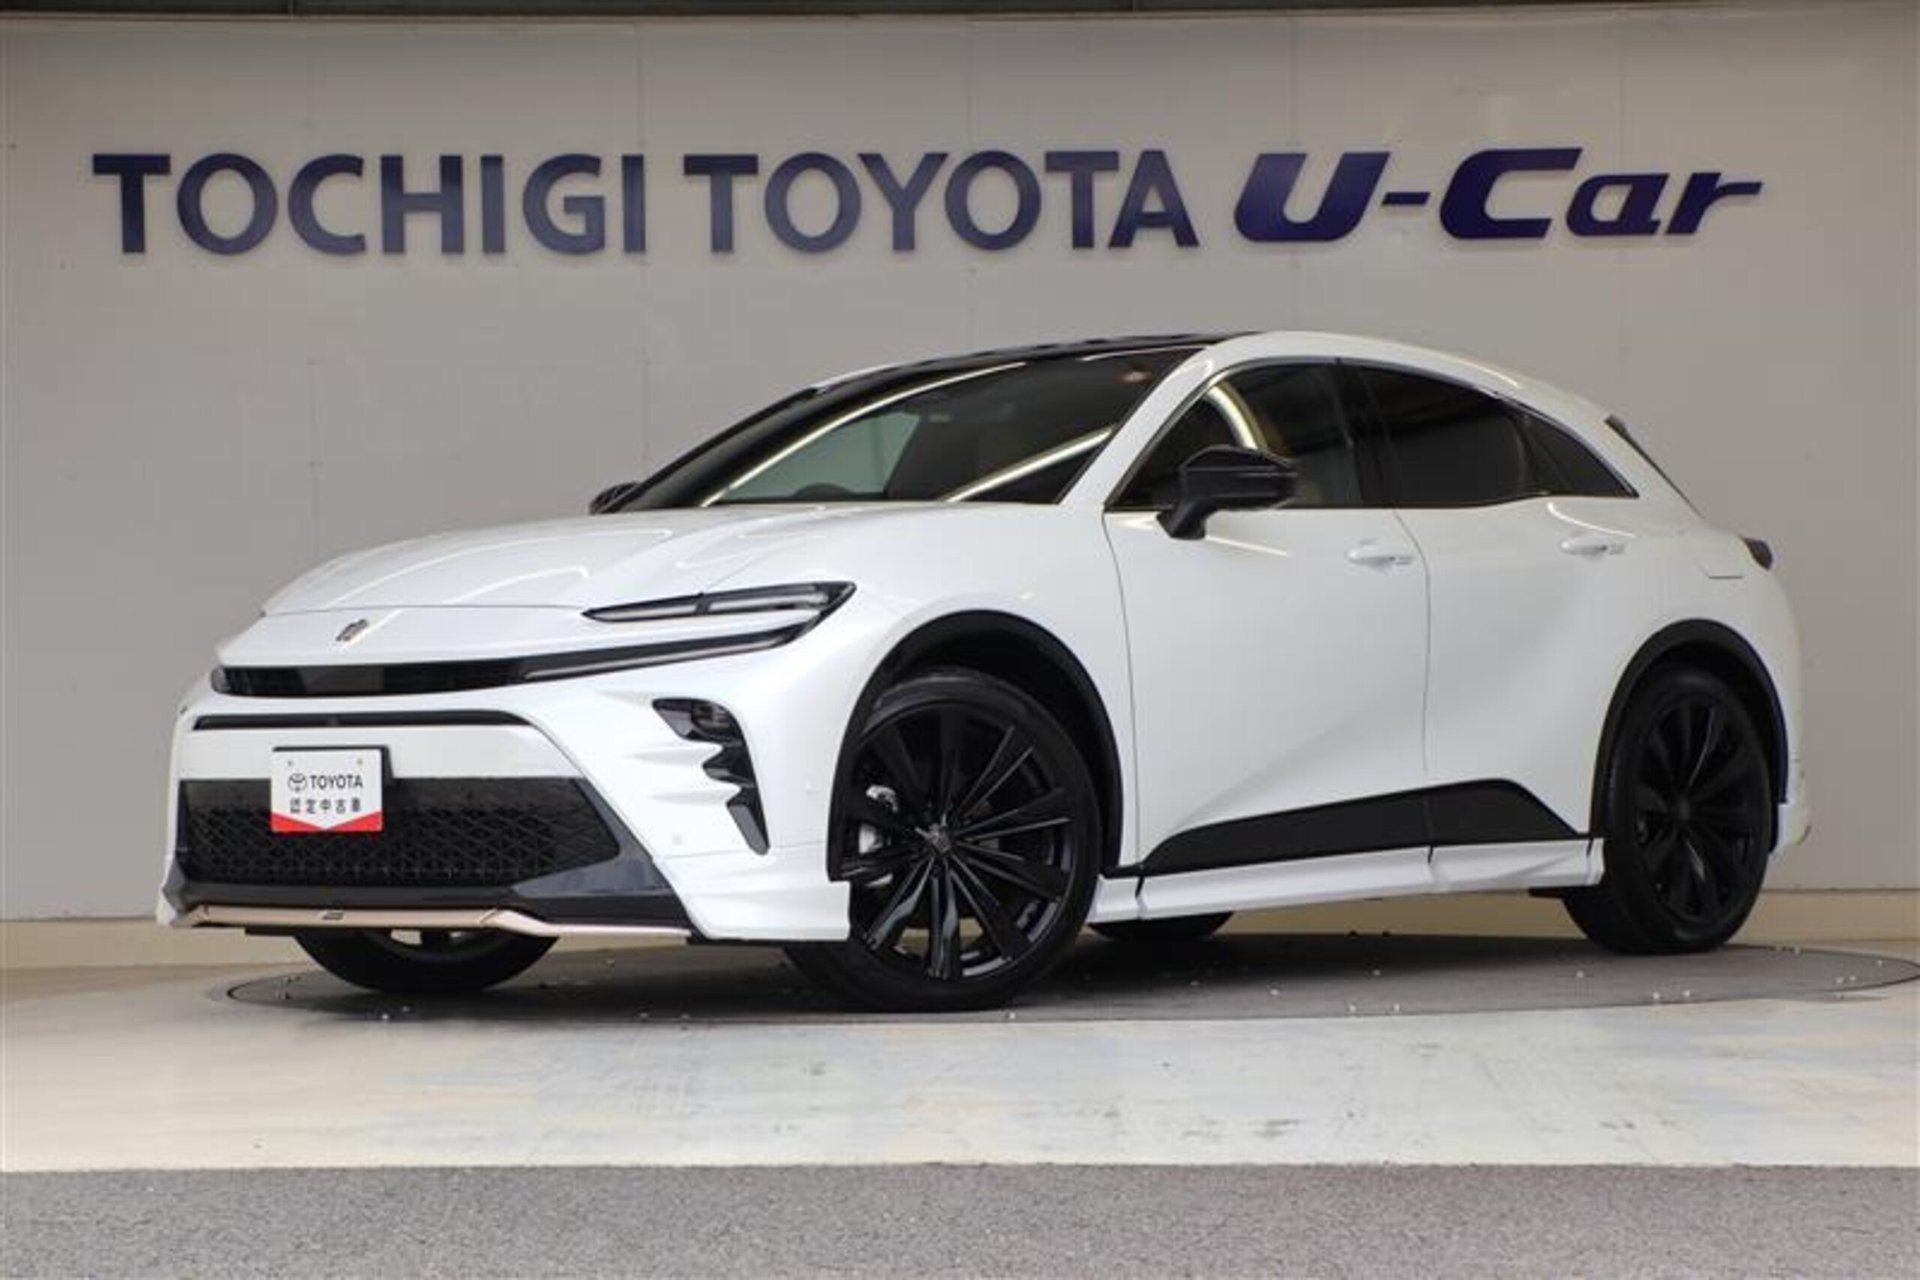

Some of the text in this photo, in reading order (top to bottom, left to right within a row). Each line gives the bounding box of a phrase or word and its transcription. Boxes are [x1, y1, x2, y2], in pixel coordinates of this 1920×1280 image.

[93, 147, 1763, 255] TOCHIGI TOYOTA U-Car
[310, 775, 363, 789] TOYOTA
